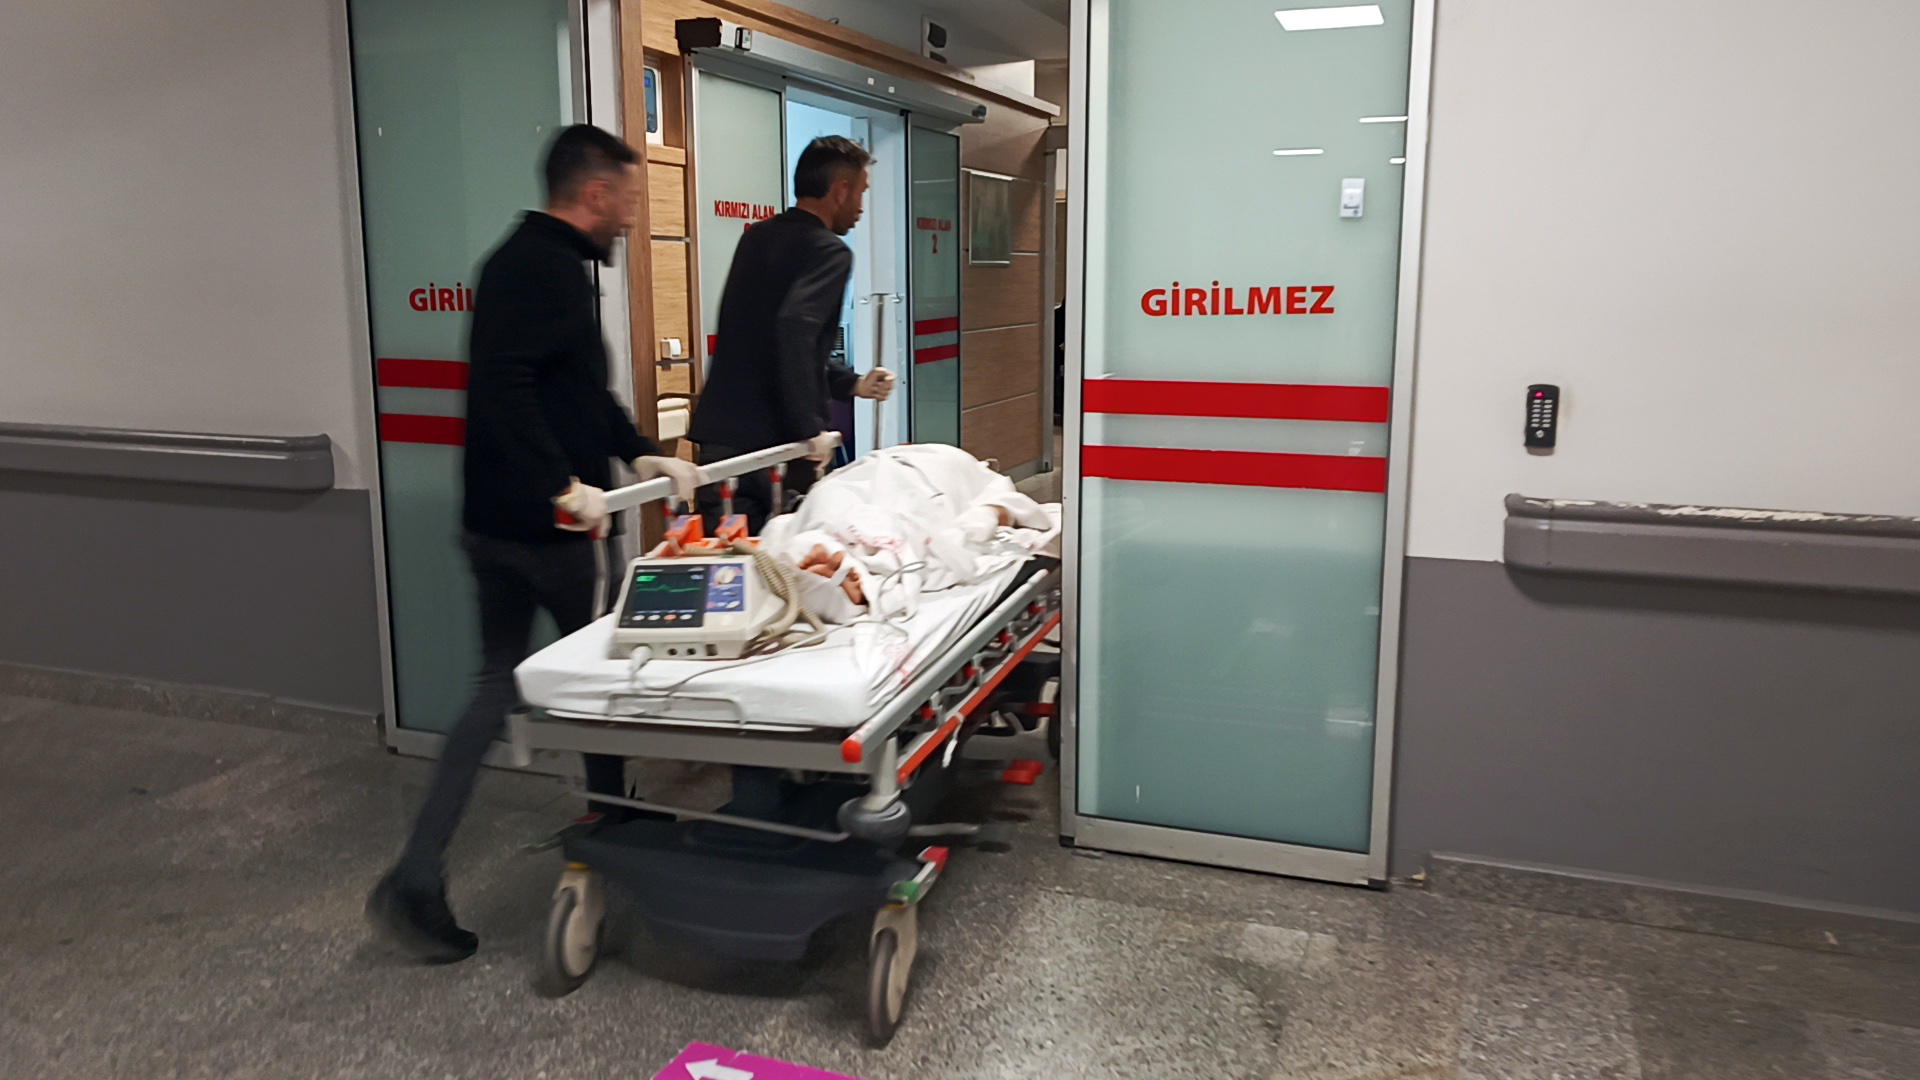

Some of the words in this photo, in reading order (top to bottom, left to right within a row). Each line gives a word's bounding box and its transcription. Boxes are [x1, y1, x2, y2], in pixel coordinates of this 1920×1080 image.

[715, 200, 749, 219] KIRMIZI
[752, 204, 775, 220] ALAN
[932, 233, 938, 254] 2
[1141, 280, 1335, 316] GİRİLMEZ
